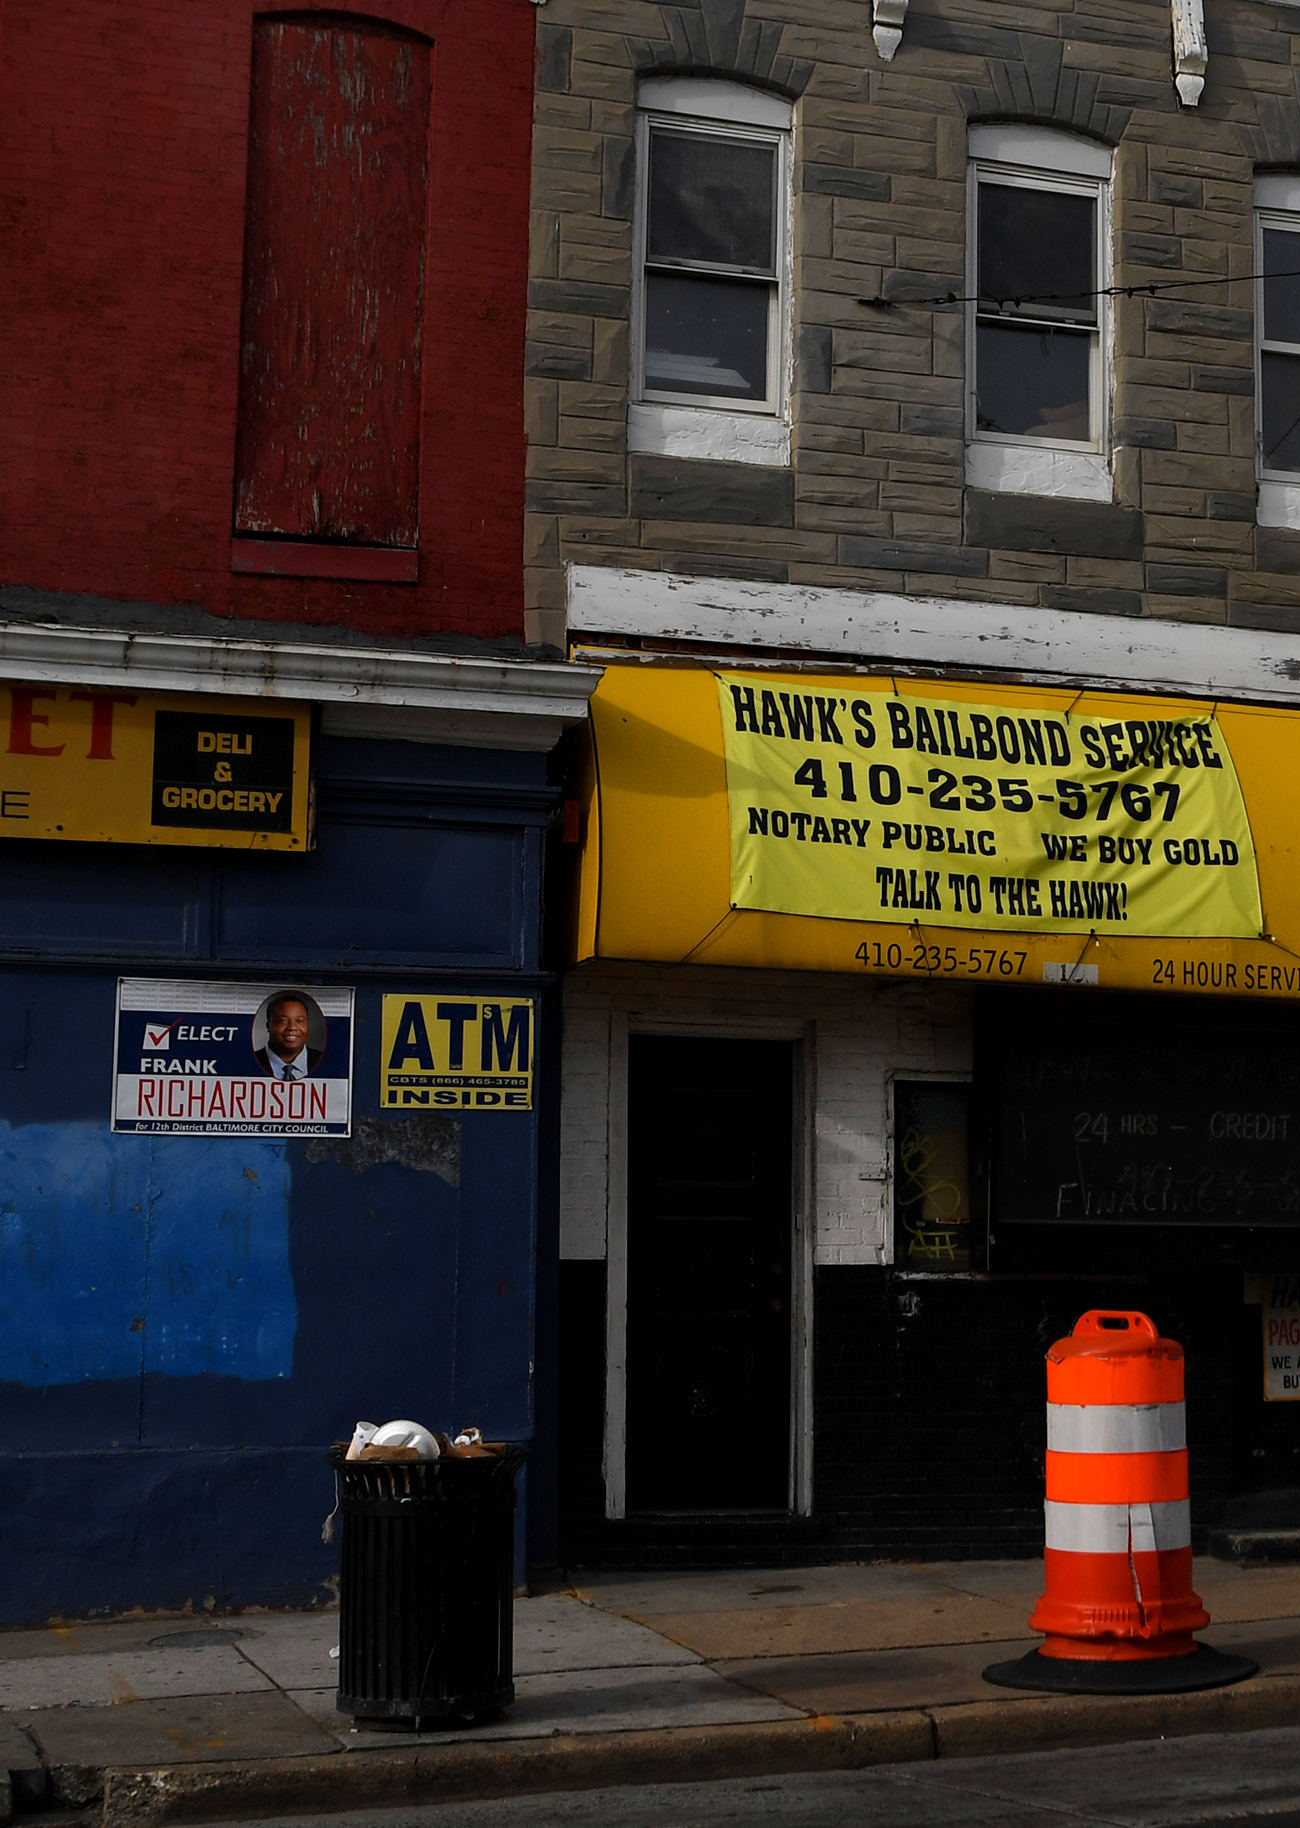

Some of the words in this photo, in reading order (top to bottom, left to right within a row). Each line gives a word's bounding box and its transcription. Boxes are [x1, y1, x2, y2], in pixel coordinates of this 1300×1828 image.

[729, 684, 877, 749] HAWK'S
[886, 702, 1071, 767] BAILBOND
[1080, 720, 1224, 772] SERVICE
[197, 731, 253, 755] DELI
[213, 761, 233, 782] &
[162, 786, 283, 814] GROCERY
[794, 758, 1182, 823] 410-235-5767
[748, 807, 871, 849] NOTARY
[882, 819, 997, 857] PUBLIC
[1041, 833, 1088, 862] WE
[1098, 835, 1152, 866] BUY
[1163, 838, 1240, 867] GOLD
[876, 867, 942, 909] TALK
[948, 873, 981, 914] TO
[989, 876, 1043, 917] THE
[1049, 880, 1129, 921] HAWK!
[855, 942, 1027, 976] 410-235-5767
[1153, 960, 1175, 984] 24
[1183, 962, 1237, 989] HOUR
[177, 1026, 239, 1042] ELECT
[388, 1002, 530, 1072] ATM
[140, 1058, 218, 1075] FRANK
[138, 1079, 327, 1119] RICHARDSON
[388, 1090, 528, 1105] INSIDE
[135, 1122, 149, 1132] for
[150, 1122, 169, 1131] 12th
[171, 1122, 204, 1132] District
[205, 1123, 260, 1132] BALTIMORE
[262, 1124, 284, 1133] CITY
[285, 1124, 329, 1133] COUNCIL
[1074, 1112, 1110, 1144] 24
[1120, 1113, 1159, 1136] HRS
[1209, 1110, 1292, 1141] CREDIT
[1272, 1356, 1291, 1369] WE
